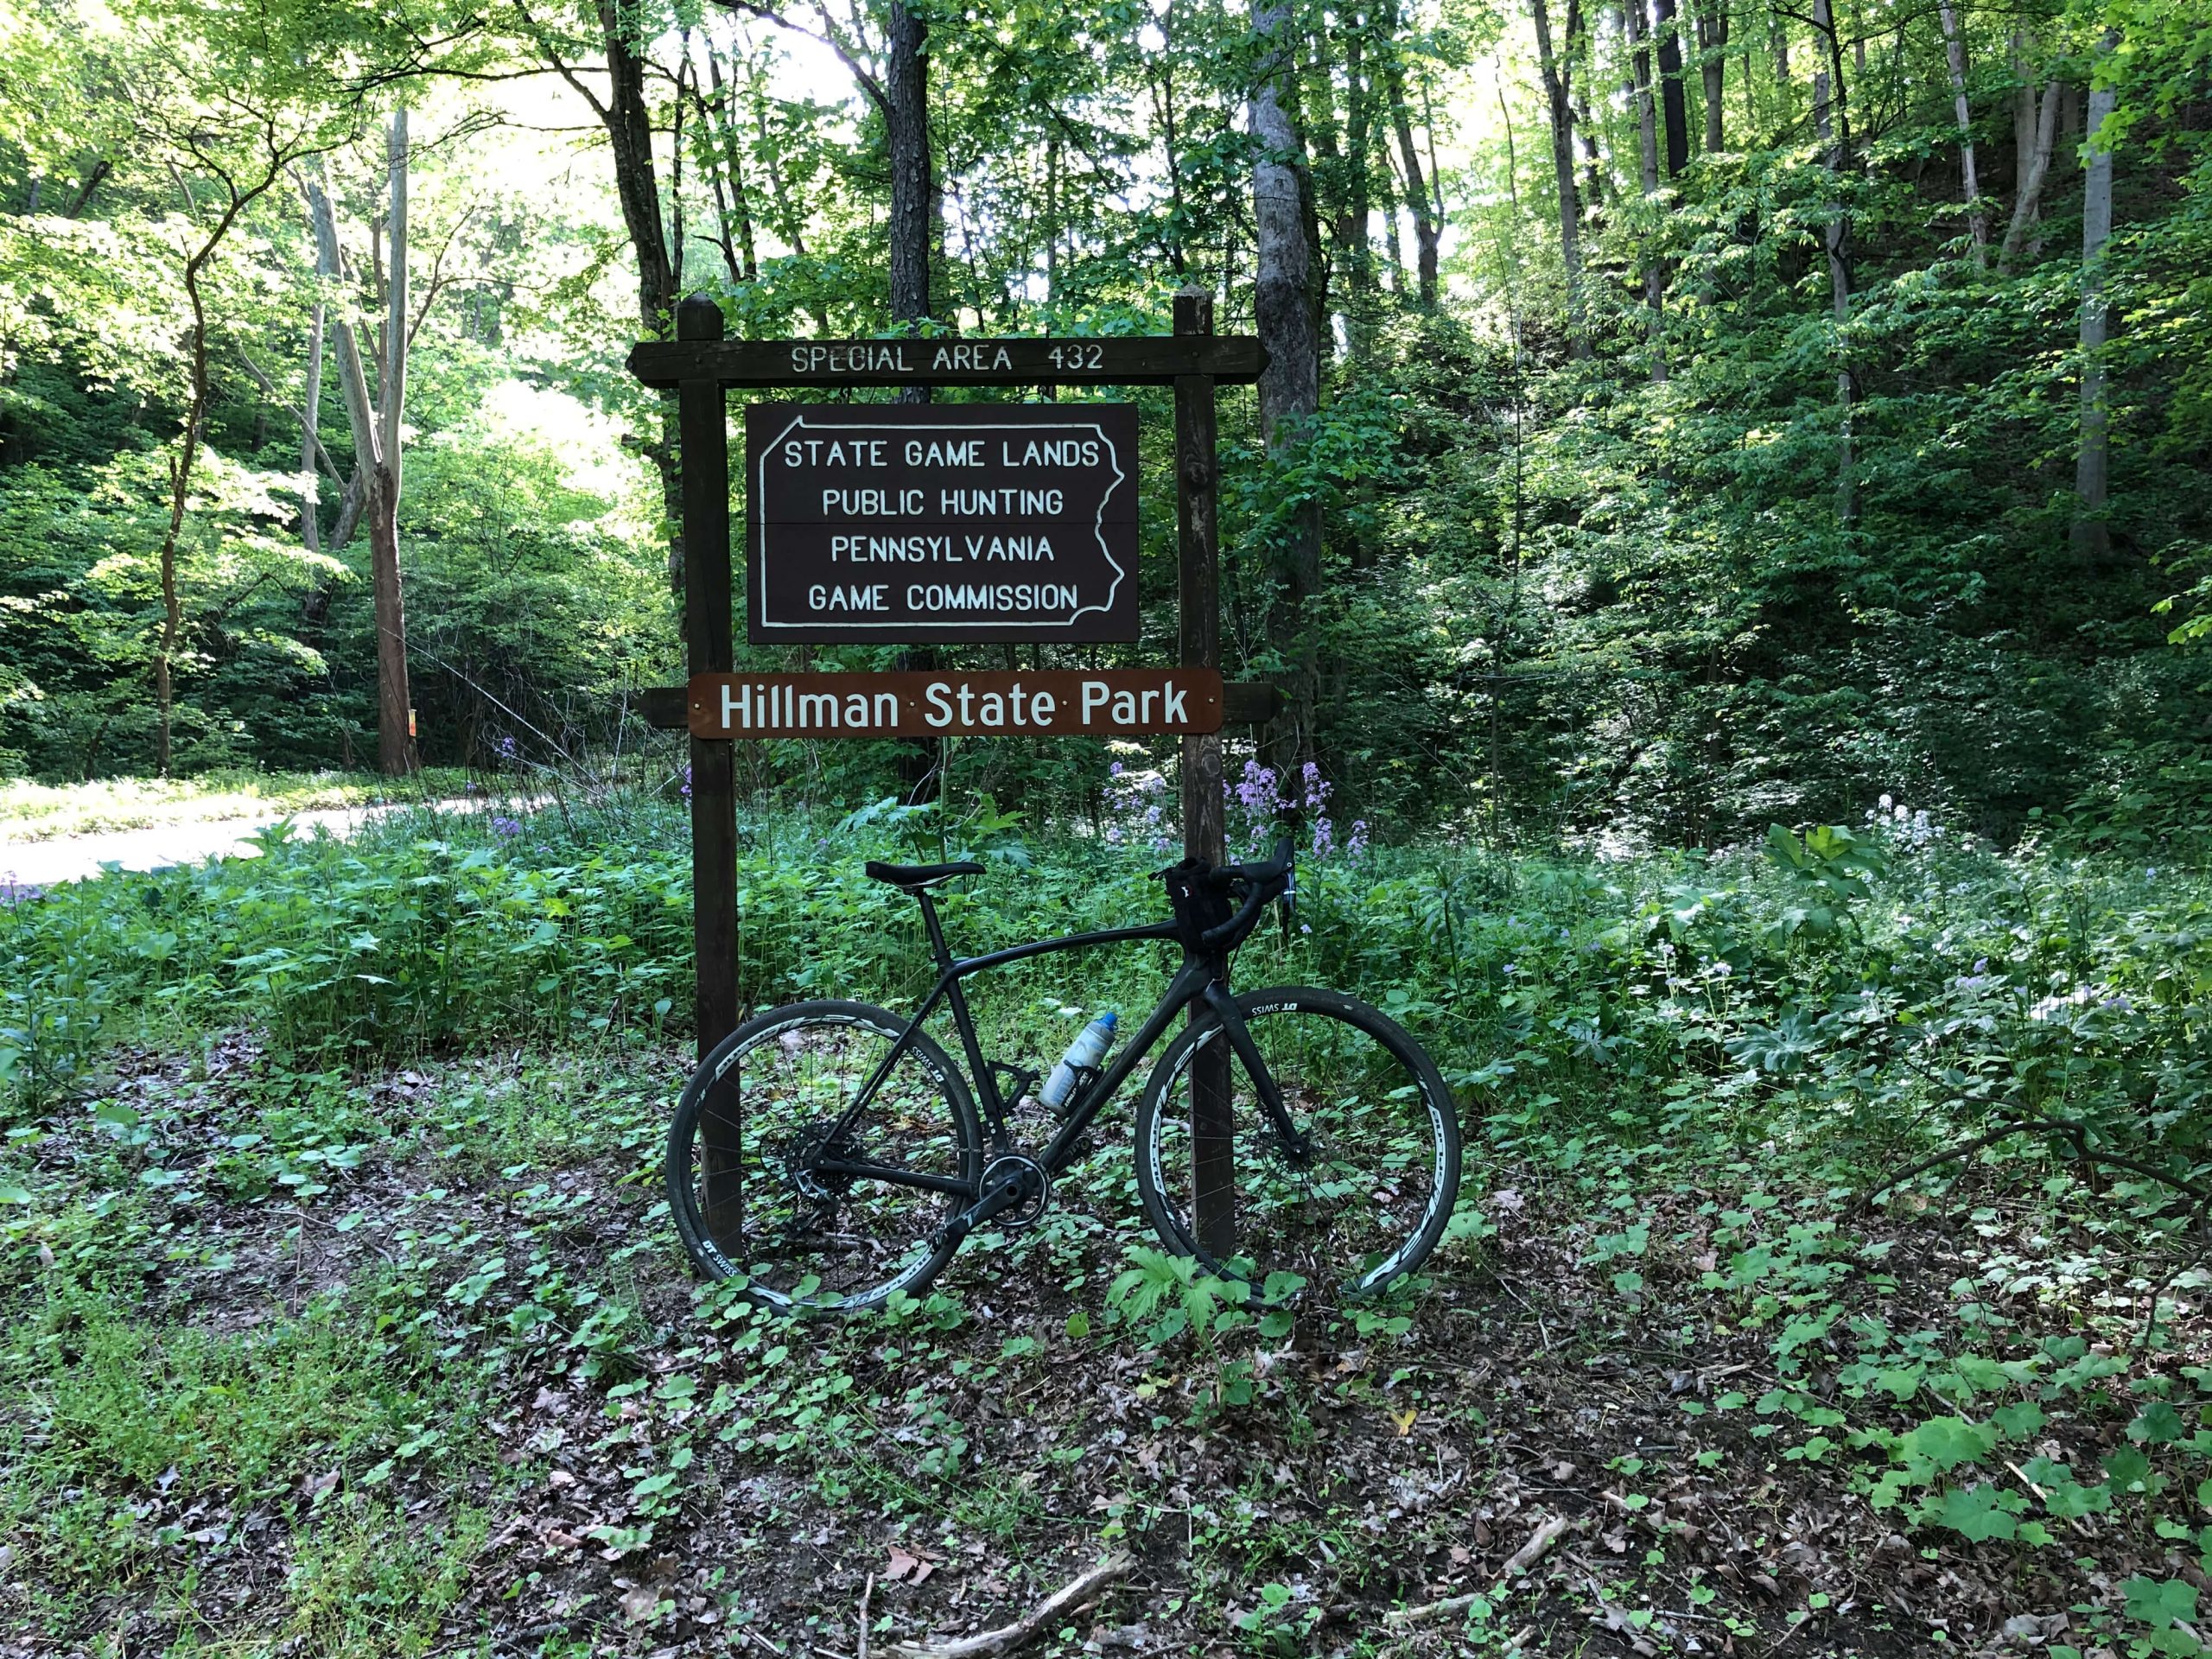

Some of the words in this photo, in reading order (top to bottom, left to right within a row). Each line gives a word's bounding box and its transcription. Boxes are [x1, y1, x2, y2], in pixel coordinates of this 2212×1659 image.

[791, 346, 913, 372] SPECIAL
[933, 346, 1012, 371] AREA
[1047, 345, 1103, 370] 432
[784, 440, 887, 467] STATE
[906, 441, 984, 467] GAME
[1003, 440, 1100, 467] LANDS
[823, 489, 924, 516] PUBLIC
[941, 489, 1063, 516] HUNTING
[831, 536, 1054, 562] PENNSYLVANIA
[809, 585, 889, 610] GAME
[907, 584, 1077, 610] COMMISSION
[721, 684, 899, 728] Hillman
[925, 682, 1056, 727] State
[1082, 680, 1188, 726] Park
[1251, 1003, 1279, 1016] SWISS
[910, 1046, 934, 1069] SWISS
[930, 1069, 945, 1083] DT
[702, 1239, 718, 1254] DT
[712, 1254, 738, 1278] SWISS
